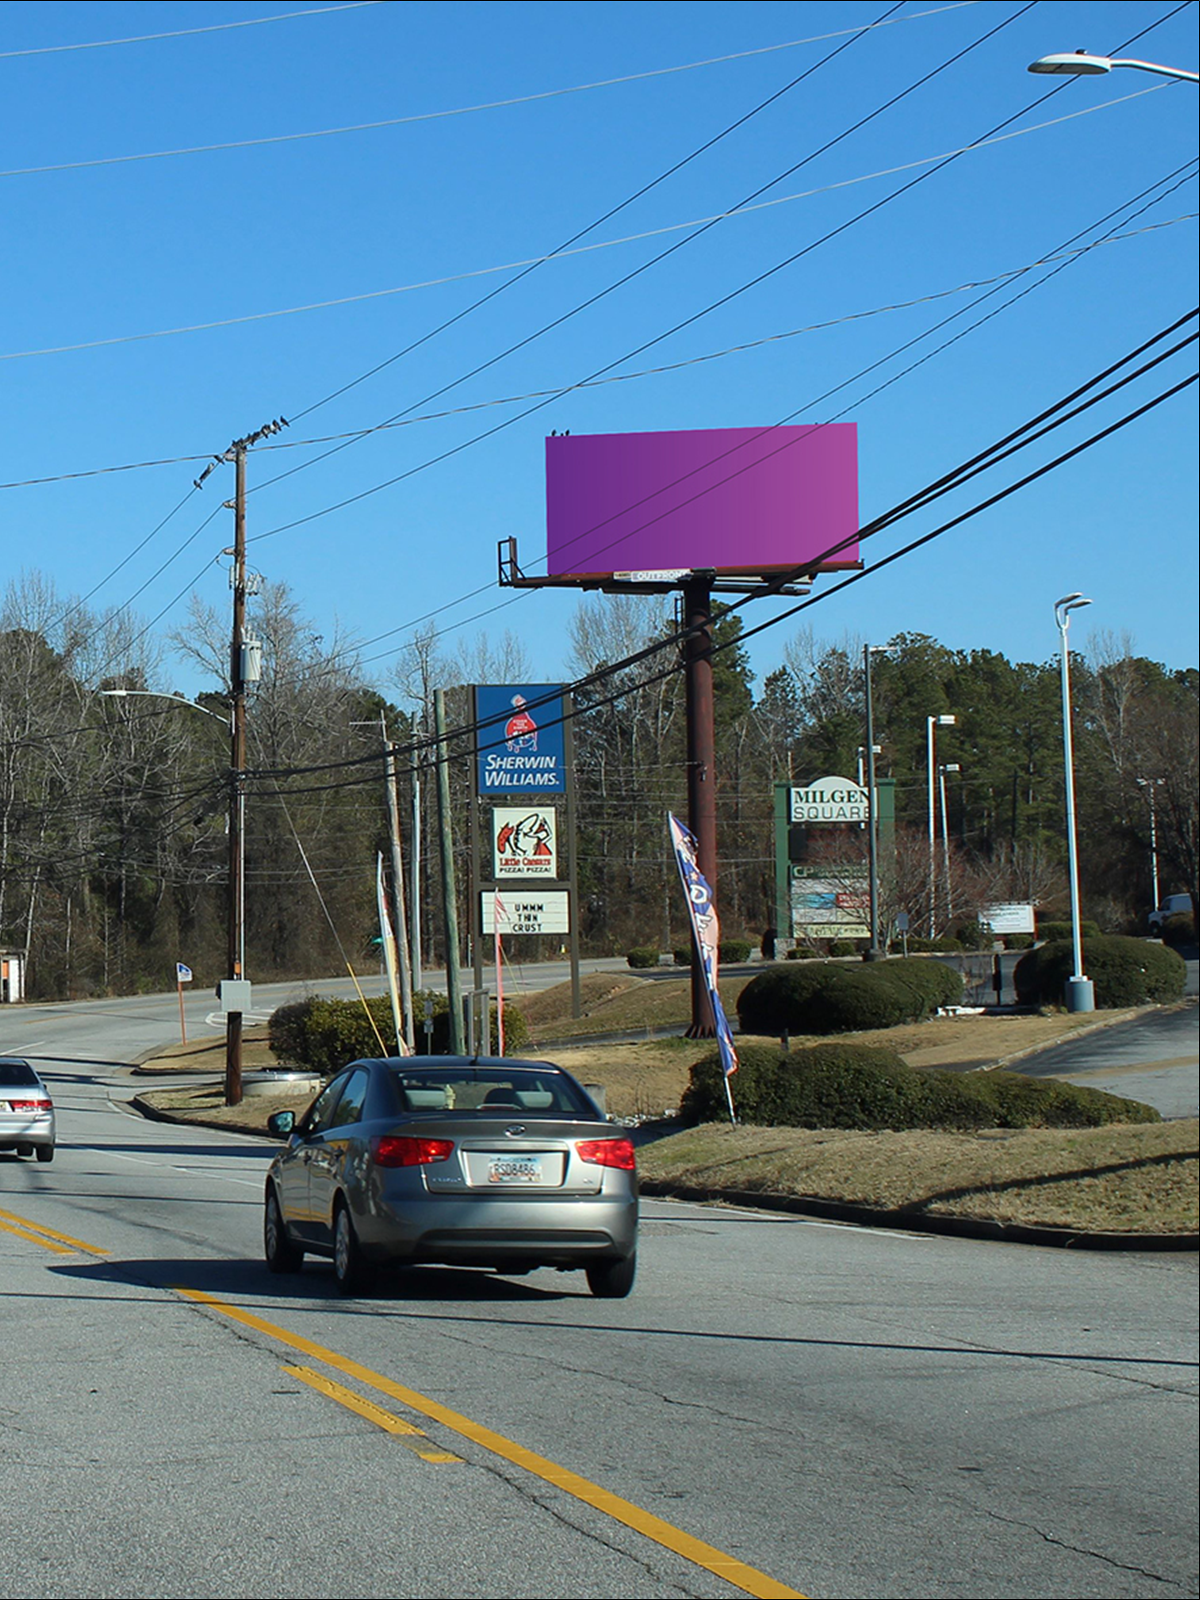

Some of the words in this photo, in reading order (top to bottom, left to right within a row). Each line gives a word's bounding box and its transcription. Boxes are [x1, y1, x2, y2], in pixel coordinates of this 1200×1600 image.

[486, 754, 556, 770] SHERWIN
[794, 790, 870, 804] MILGEN
[514, 904, 544, 912] UMMM
[512, 924, 542, 932] CRUST
